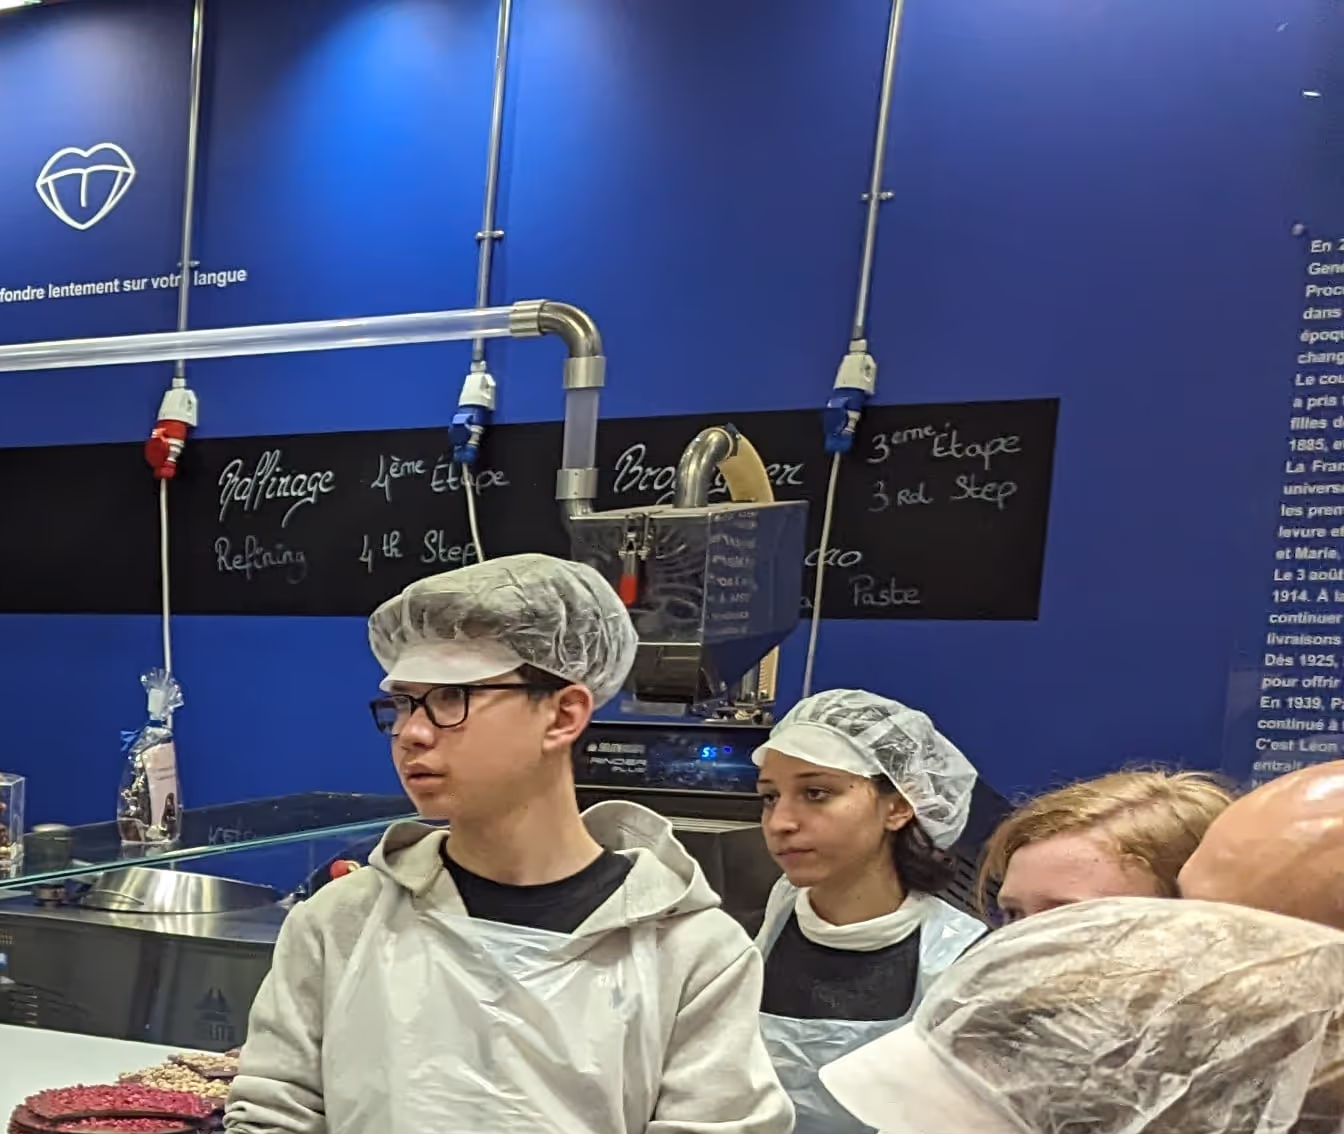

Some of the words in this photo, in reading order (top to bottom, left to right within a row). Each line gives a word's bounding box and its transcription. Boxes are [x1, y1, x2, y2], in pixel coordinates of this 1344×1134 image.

[1311, 240, 1331, 252] En
[0, 284, 45, 303] fondre
[48, 277, 119, 299] lentement
[123, 277, 146, 292] sur
[151, 274, 182, 290] votr
[193, 268, 248, 289] langue
[1303, 307, 1342, 320] dans
[1295, 374, 1314, 386] Le
[1306, 396, 1336, 410] pris
[1290, 416, 1327, 430] filles
[1286, 460, 1305, 473] La
[1281, 504, 1303, 516] les
[1275, 548, 1291, 559] et
[1274, 568, 1292, 580] Le
[1297, 569, 1305, 580] 3
[1269, 611, 1343, 624] continuer
[1267, 632, 1342, 645] livraisons
[1262, 677, 1298, 690] pour
[1302, 675, 1341, 688] offrir
[1260, 696, 1281, 708] En
[1257, 719, 1324, 731] continué
